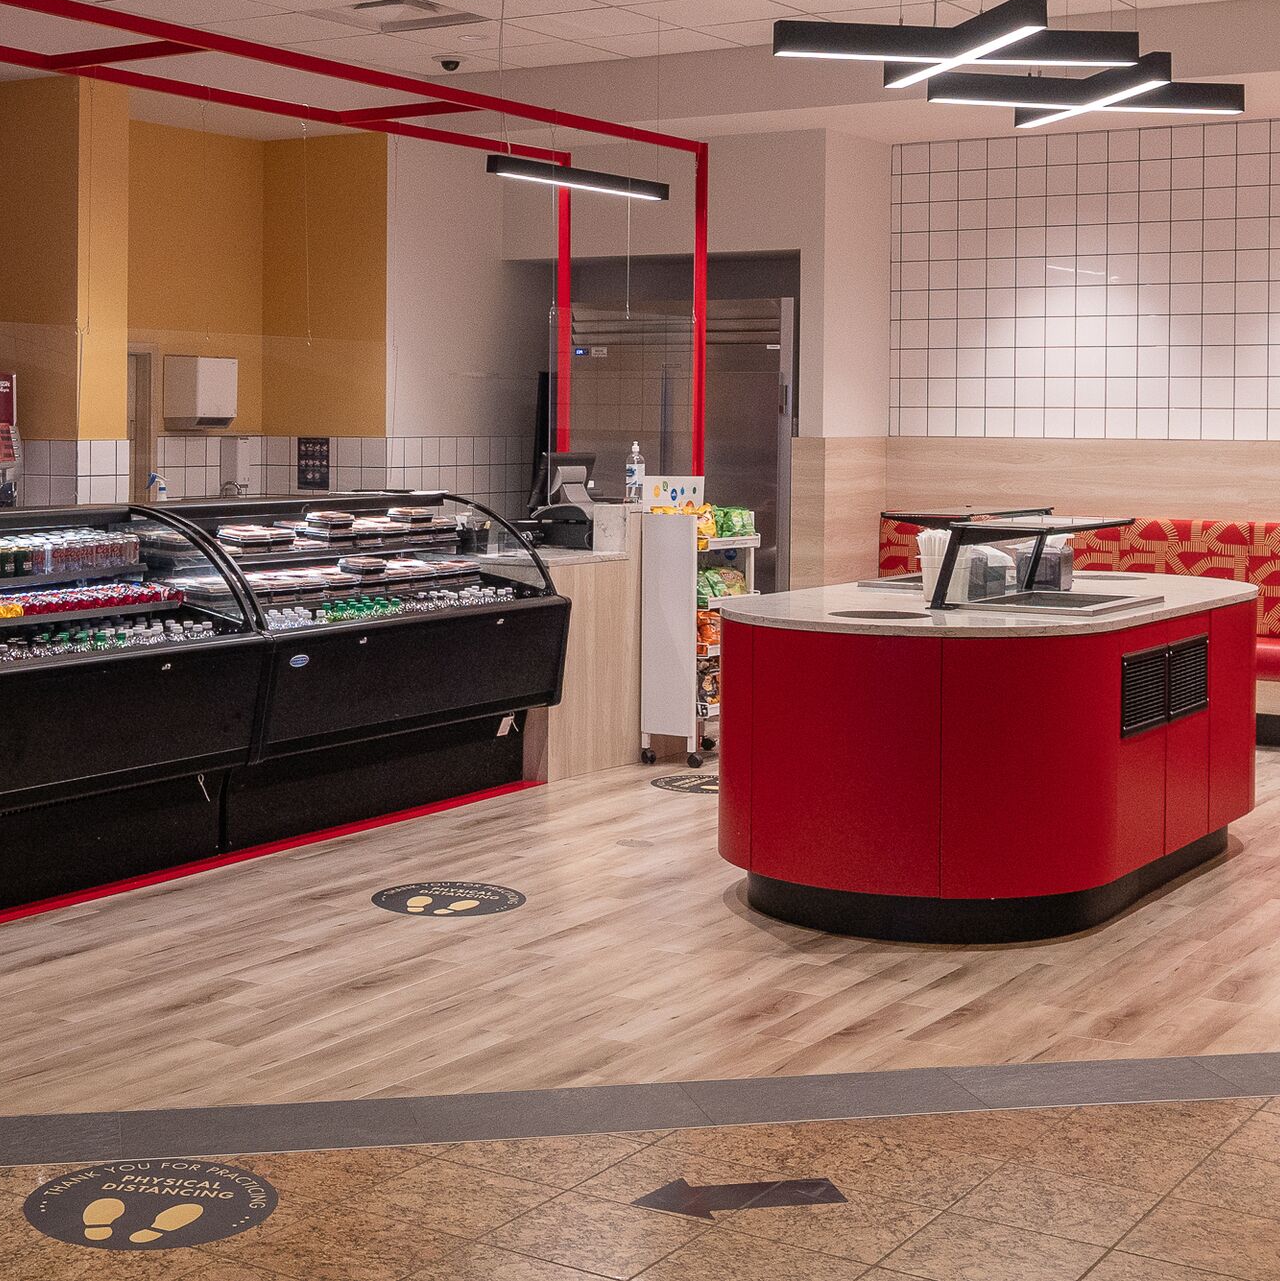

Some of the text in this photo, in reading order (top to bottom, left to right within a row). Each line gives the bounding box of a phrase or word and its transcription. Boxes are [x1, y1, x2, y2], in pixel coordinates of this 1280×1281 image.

[419, 889, 500, 900] DISTANCING
[431, 887, 492, 896] PHYSICAL
[44, 1162, 267, 1210] THANK YOU FOR PRACTICING
[120, 1174, 221, 1190] PHYSICAL
[101, 1182, 235, 1200] DISTANCING
